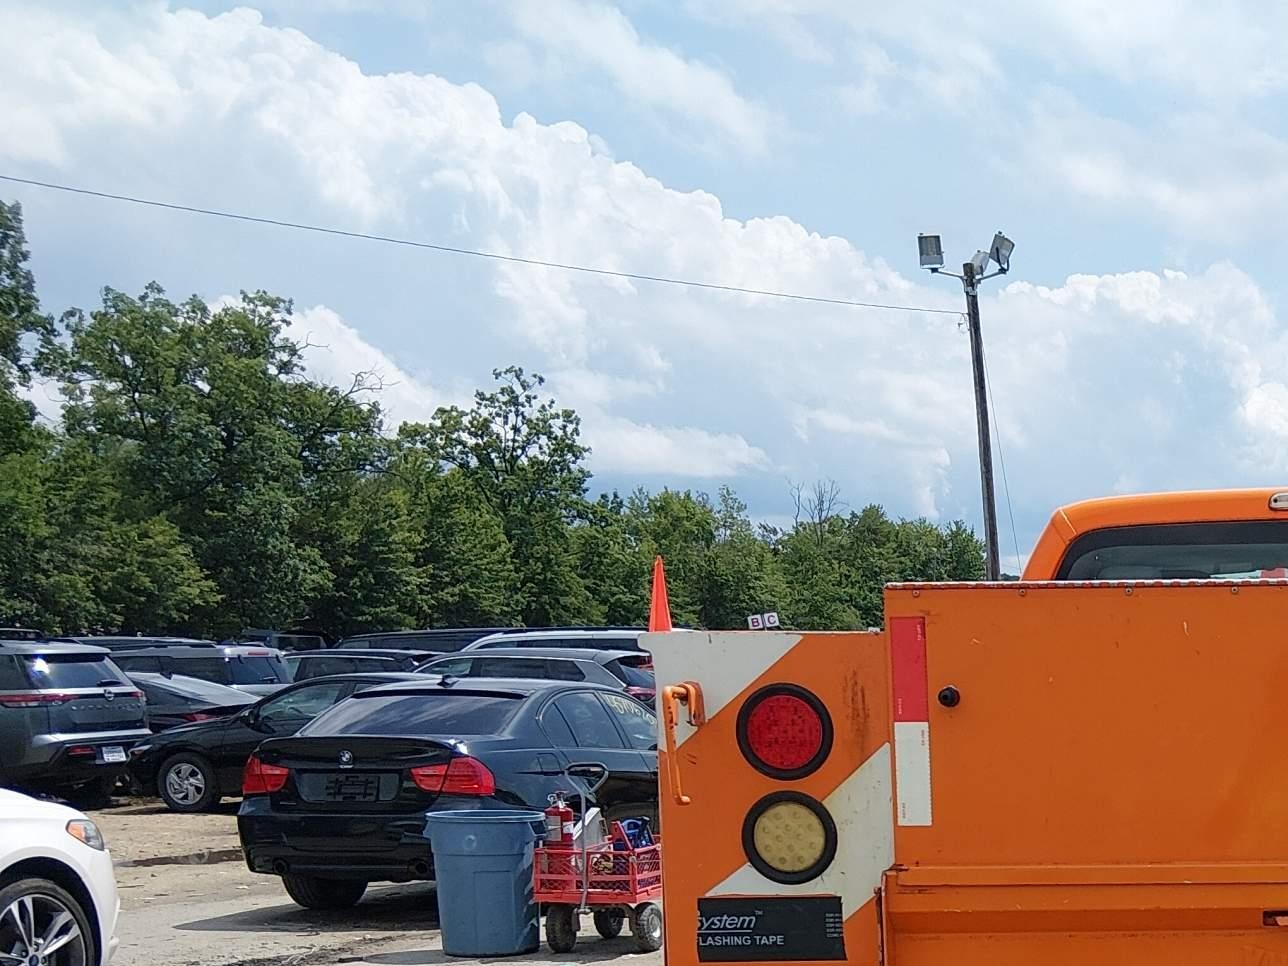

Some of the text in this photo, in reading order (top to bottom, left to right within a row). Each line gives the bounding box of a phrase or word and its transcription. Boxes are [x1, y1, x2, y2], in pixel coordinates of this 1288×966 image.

[697, 911, 756, 930] ystem
[698, 935, 784, 946] LASHING TAPE
